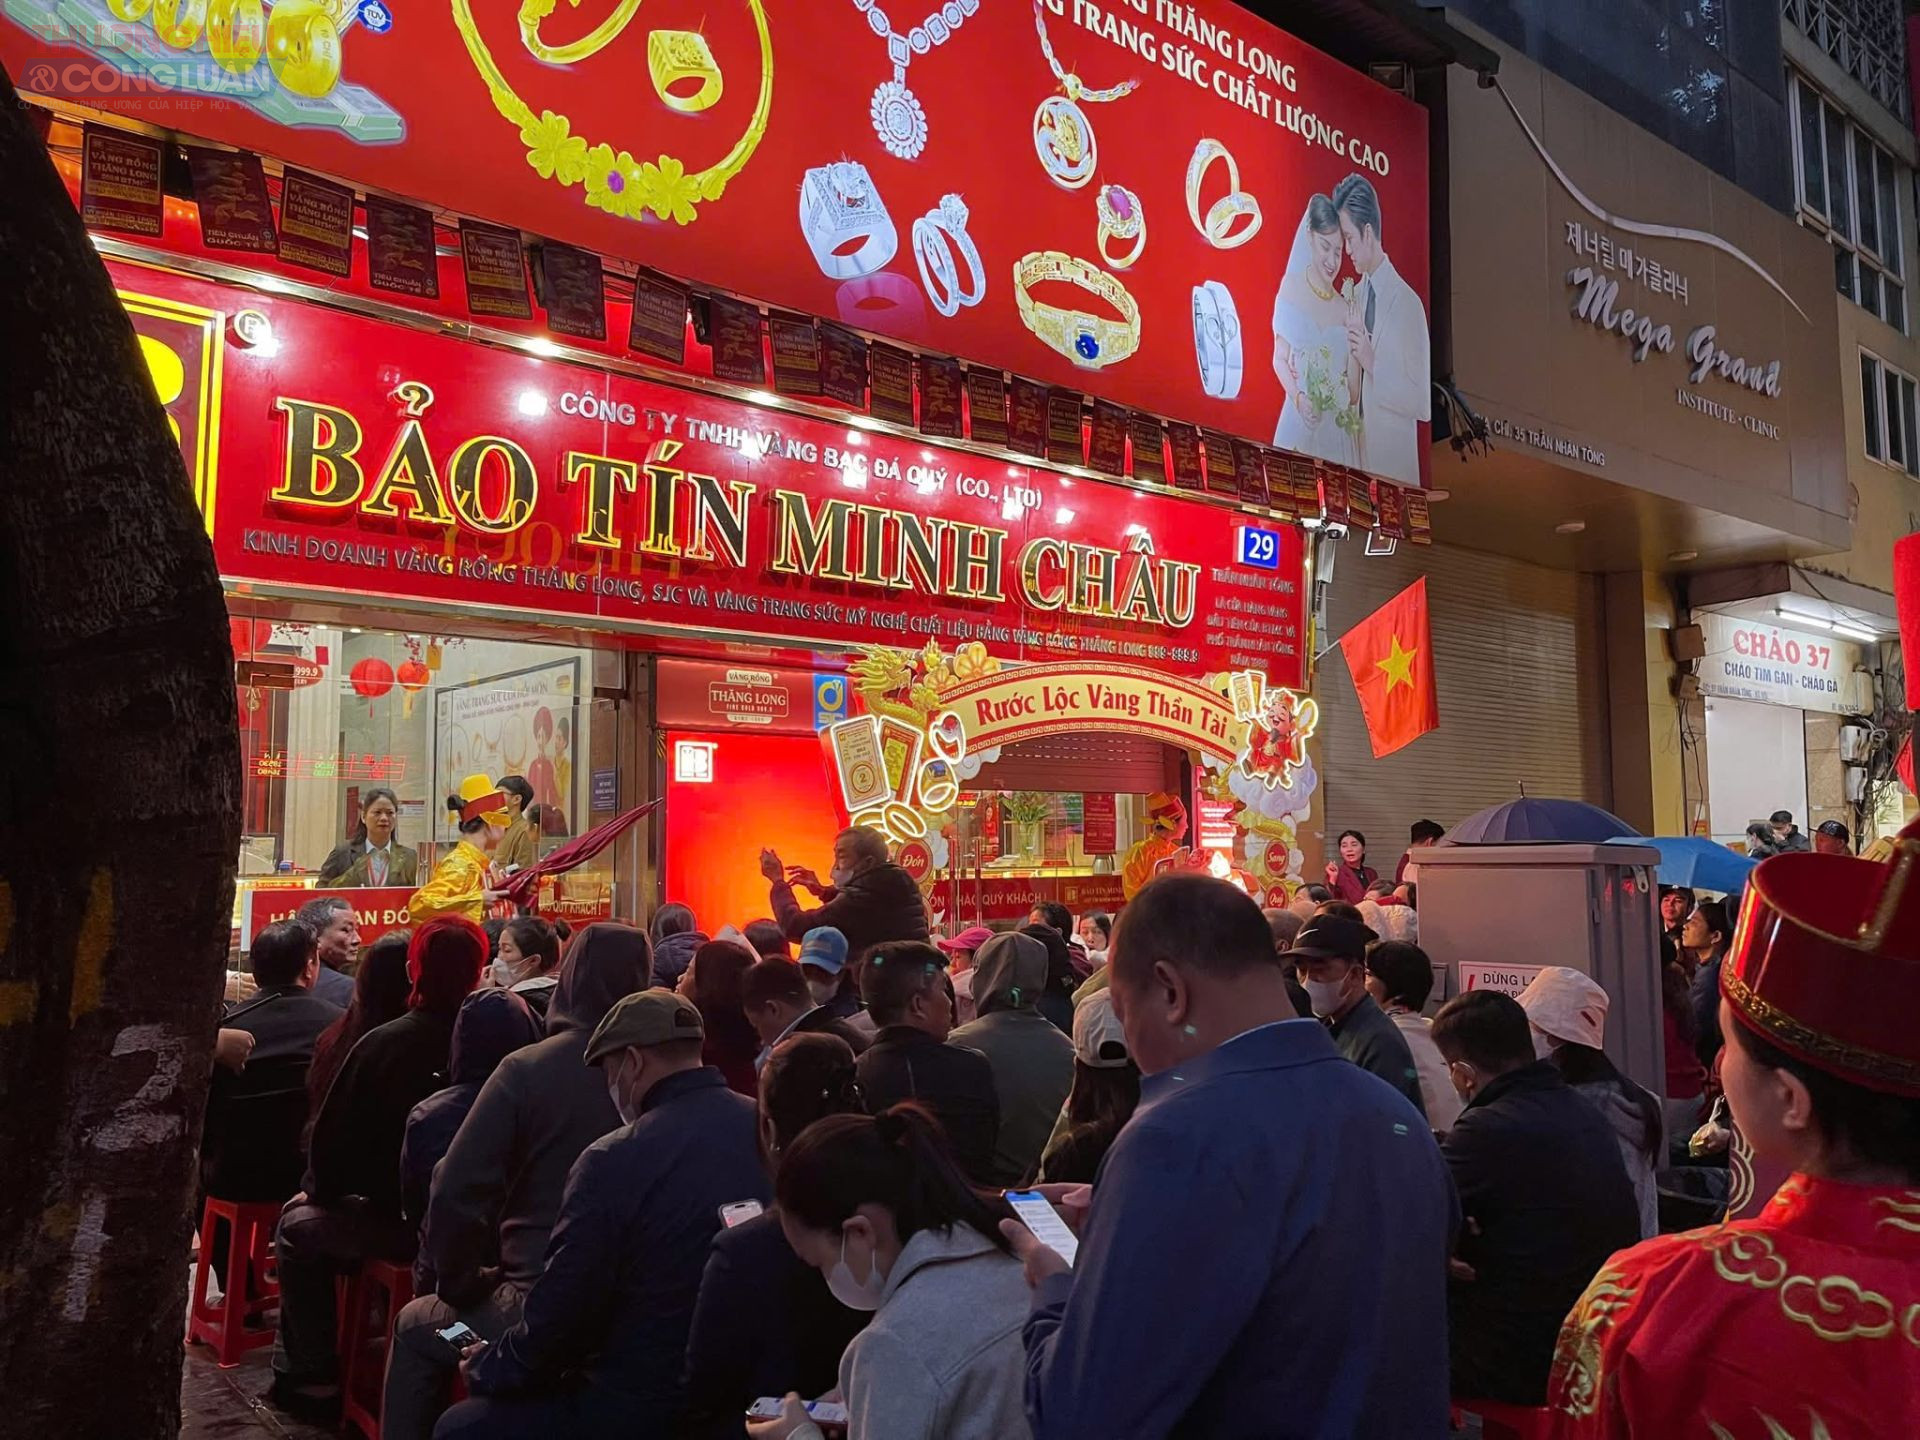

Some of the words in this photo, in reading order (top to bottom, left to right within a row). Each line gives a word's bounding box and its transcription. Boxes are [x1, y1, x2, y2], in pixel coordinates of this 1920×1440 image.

[1155, 0, 1232, 59] THĂNG
[1238, 38, 1297, 92] LONG
[1073, 0, 1156, 62] TRANG
[1162, 44, 1209, 88] SỨC
[1213, 69, 1273, 119] CHẤT
[1275, 98, 1345, 156] LƯỢNG
[1349, 138, 1390, 177] CAO
[1569, 267, 1675, 362] Mega
[1687, 325, 1781, 398] Grand
[1676, 388, 1736, 424] INSTITUTE
[1744, 414, 1780, 440] CLINIC
[560, 390, 636, 426] CÔNG
[643, 409, 678, 434] TY
[686, 417, 749, 449] TNHH
[755, 431, 818, 463] VÀNG
[874, 456, 902, 482] ĐÁ
[1514, 426, 1526, 442] 35
[1528, 428, 1553, 451] TRẦN
[1555, 439, 1579, 459] NHÂN
[1582, 446, 1606, 467] TÔNG
[268, 381, 538, 534] BẢO
[560, 439, 757, 568] TÍN
[769, 489, 1008, 604] MINH
[1020, 532, 1202, 628] CHÂU
[1248, 532, 1274, 560] 29
[243, 528, 300, 557] KINH
[305, 538, 389, 568] DOANH
[395, 545, 454, 575] VÀNG
[459, 554, 516, 583] RỒNG
[523, 566, 588, 592] THĂNG
[593, 576, 647, 604] LONG,
[652, 583, 684, 604] SJC
[688, 585, 708, 607] VÀ
[715, 588, 757, 613] VÀNG
[762, 597, 811, 620] TRANG
[814, 601, 844, 624] SỨC
[846, 607, 867, 626] MỸ
[871, 610, 908, 634] NGHỆ
[910, 611, 943, 635] CHẤT
[946, 618, 973, 640] LIỆU
[976, 619, 1009, 642] BẰNG
[1079, 633, 1116, 656] THĂNG
[1118, 640, 1147, 658] LONG
[1733, 629, 1801, 665] CHÁO
[1807, 644, 1831, 671] 37
[295, 666, 318, 677] 999.9
[1724, 660, 1751, 677] CHÁO
[1754, 666, 1772, 683] TIM
[1774, 670, 1793, 686] GAN
[1801, 673, 1825, 692] CHÁO
[1826, 678, 1838, 694] GÀ
[711, 688, 753, 704] THĂNG
[755, 692, 786, 706] LONG
[976, 691, 1035, 726] Rước
[1043, 684, 1080, 716] Lộc
[1087, 684, 1140, 716] Vàng
[1147, 690, 1193, 724] Thần
[1201, 706, 1227, 740] Tài
[902, 854, 924, 868] Đón
[1267, 851, 1287, 864] Sang
[1006, 889, 1042, 905] KHÁCH
[1483, 971, 1518, 986] DỪNG
